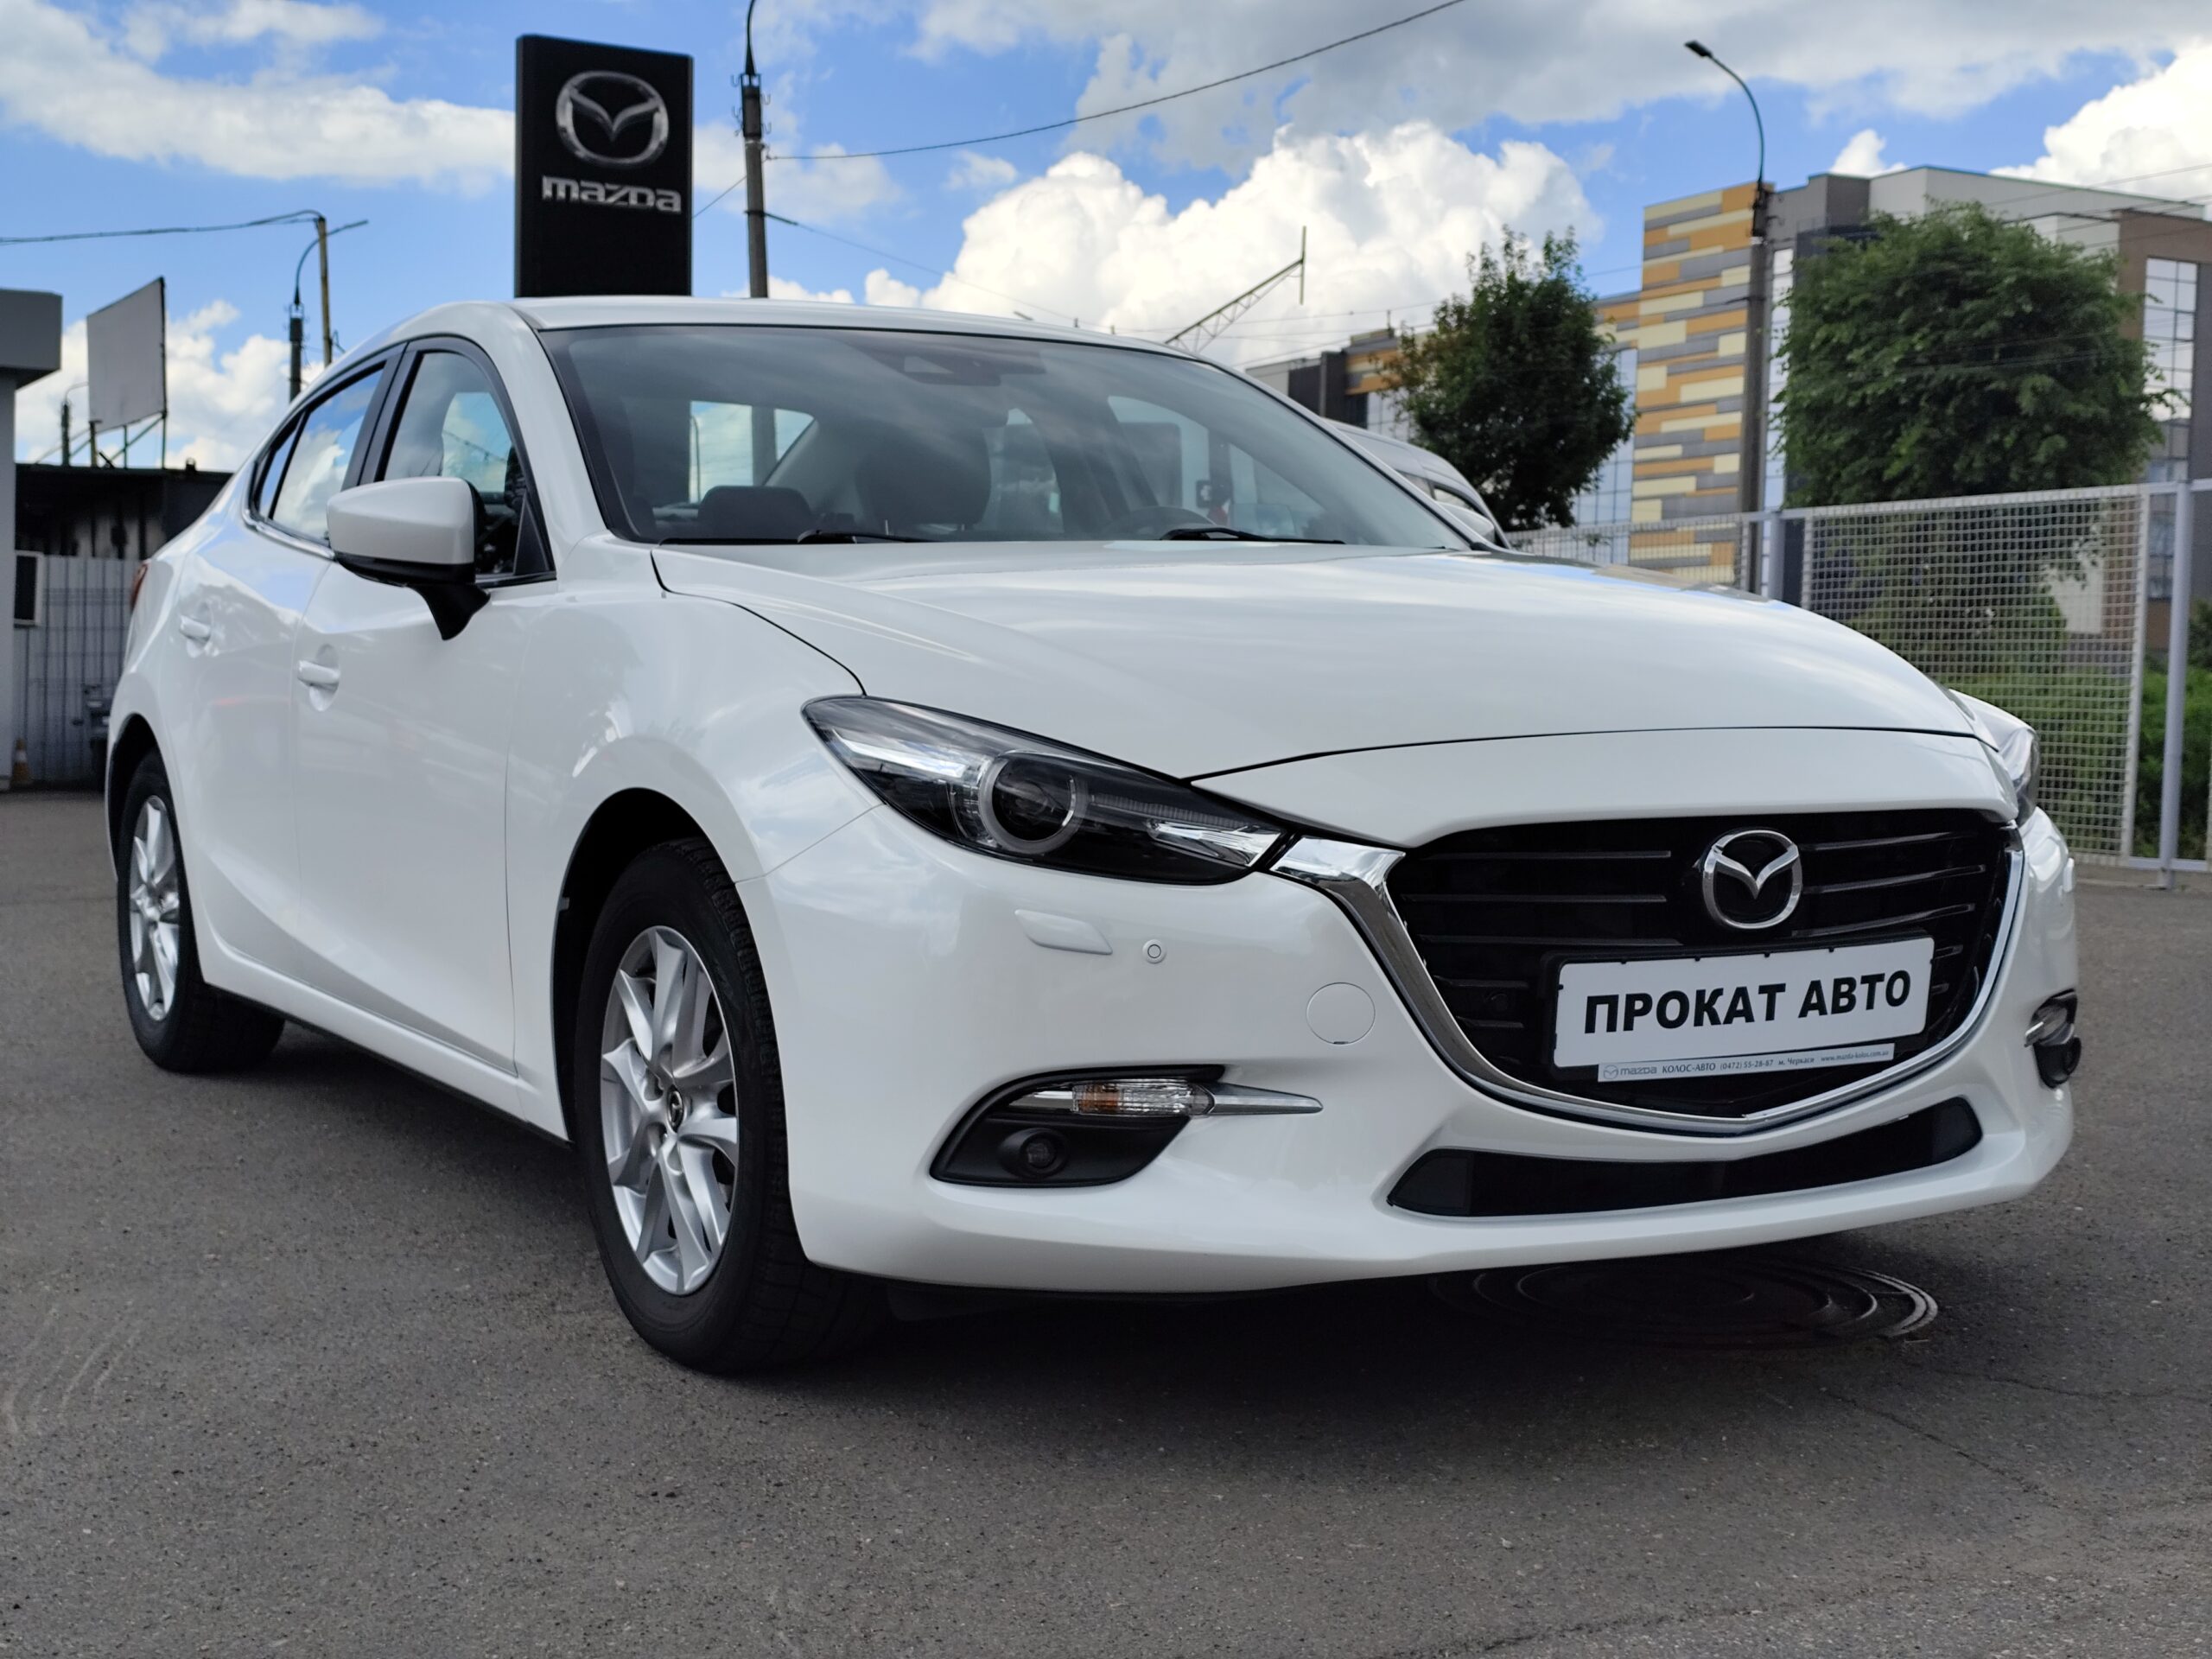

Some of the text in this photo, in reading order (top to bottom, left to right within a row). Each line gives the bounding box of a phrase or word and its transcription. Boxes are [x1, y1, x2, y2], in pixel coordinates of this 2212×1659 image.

[1584, 969, 1911, 1034] ПРОКАТ АВТО
[1662, 1062, 1716, 1074] КОЛОС-АВТО
[1719, 1061, 1742, 1071] (0472)
[1787, 1057, 1815, 1065] Черкаси
